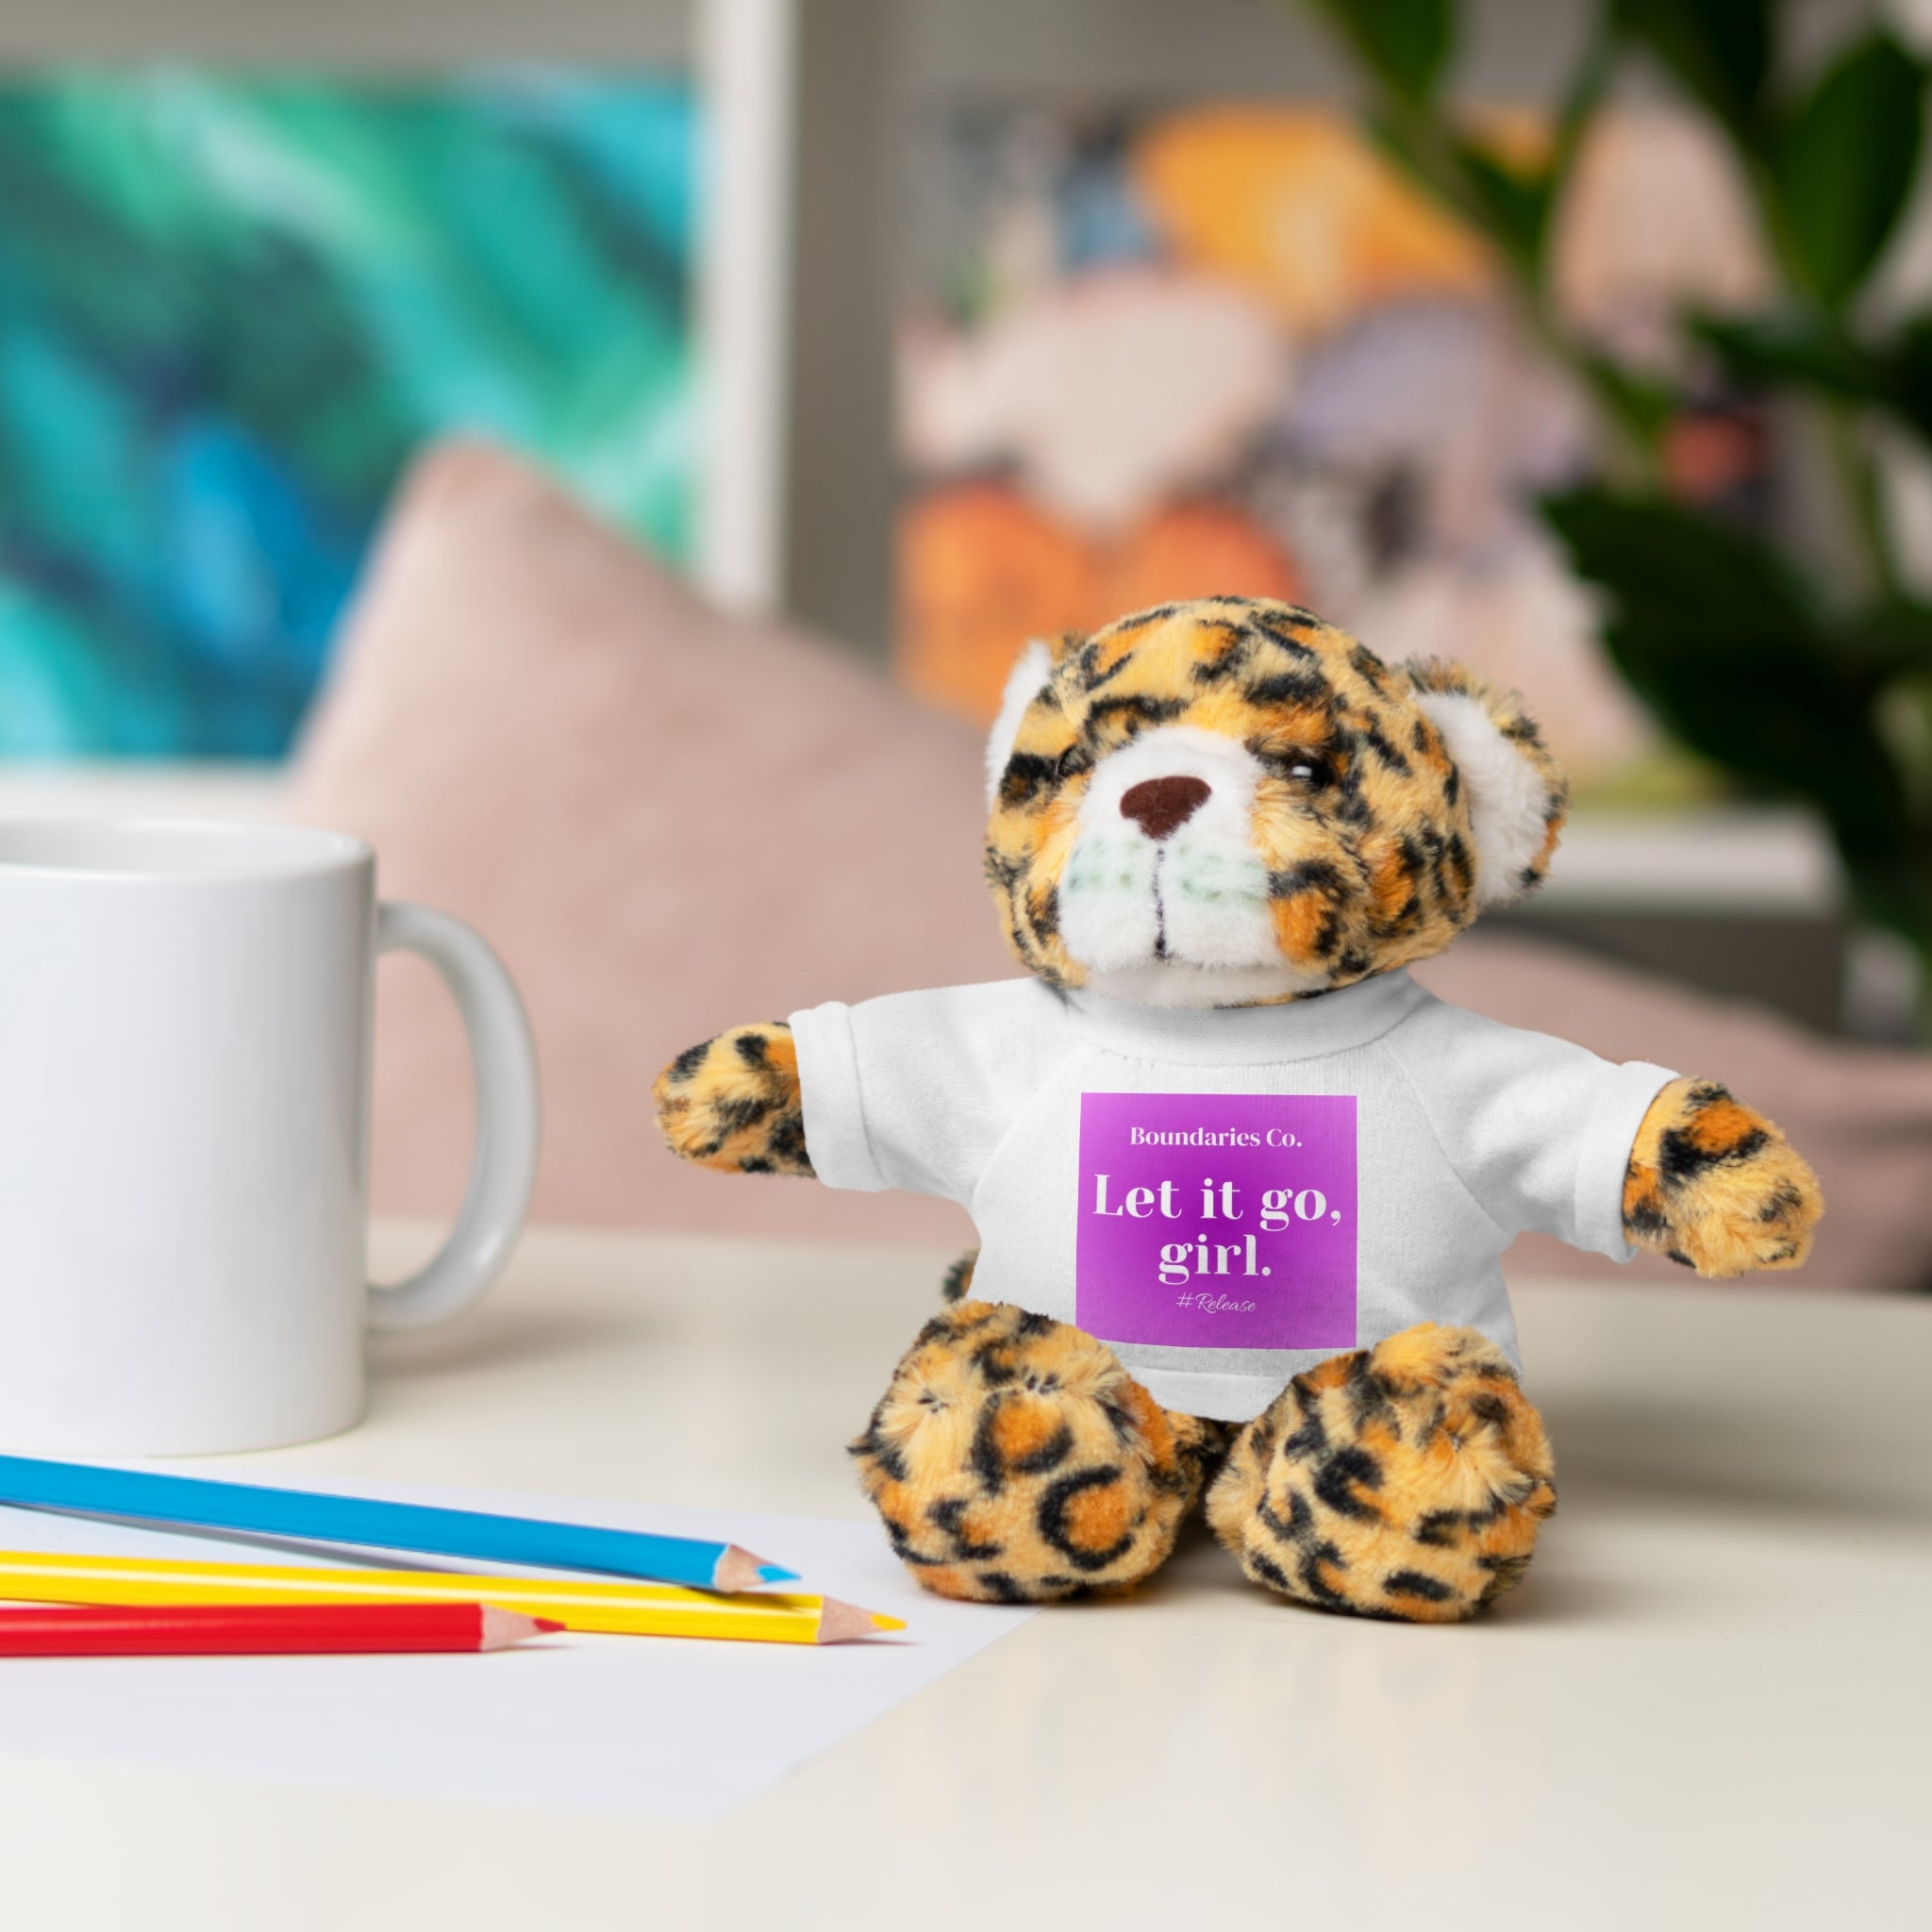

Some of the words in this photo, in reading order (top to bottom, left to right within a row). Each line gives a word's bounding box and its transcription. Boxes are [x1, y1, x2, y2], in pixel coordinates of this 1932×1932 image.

[1130, 1126, 1261, 1147] Boundaries
[1266, 1128, 1303, 1147] Co.
[1092, 1174, 1182, 1219] Let
[1200, 1177, 1244, 1220] it
[1259, 1188, 1341, 1232] go,
[1158, 1233, 1272, 1285] girl.
[1176, 1291, 1257, 1314] #Release
